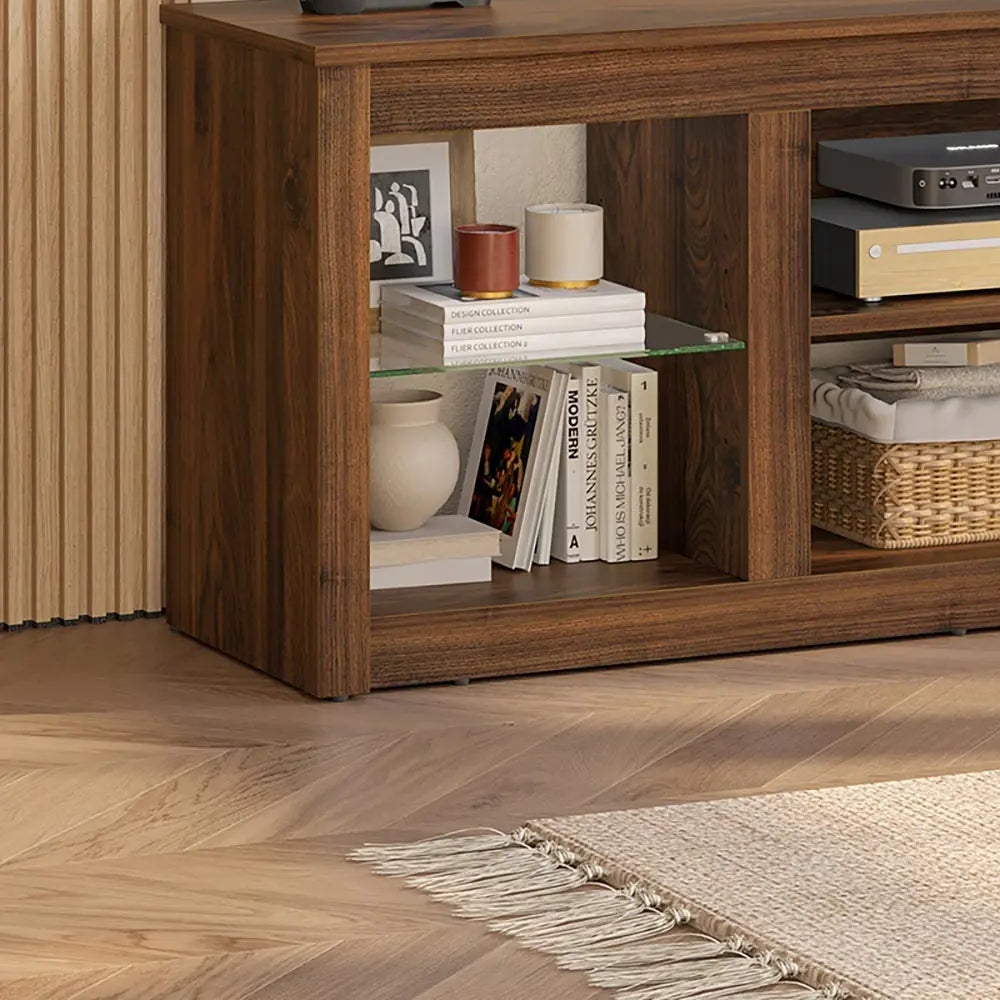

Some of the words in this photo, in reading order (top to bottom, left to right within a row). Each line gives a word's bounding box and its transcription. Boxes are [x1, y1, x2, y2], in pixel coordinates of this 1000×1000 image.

[451, 310, 480, 319] DESIGN
[481, 307, 530, 317] COLLECTION
[451, 327, 472, 336] FLIER
[474, 324, 523, 334] COLLECTION
[451, 344, 472, 353] FLIER
[473, 340, 522, 351] COLLECTION
[641, 381, 647, 391] 1
[568, 390, 579, 459] MODERN
[584, 377, 598, 450] GRÜTZKE
[615, 405, 626, 448] JANG?
[615, 449, 626, 509] MICHAEL
[585, 452, 598, 532] JOHANNES
[615, 510, 626, 524] IS
[569, 534, 579, 549] A
[615, 526, 626, 561] WHO
